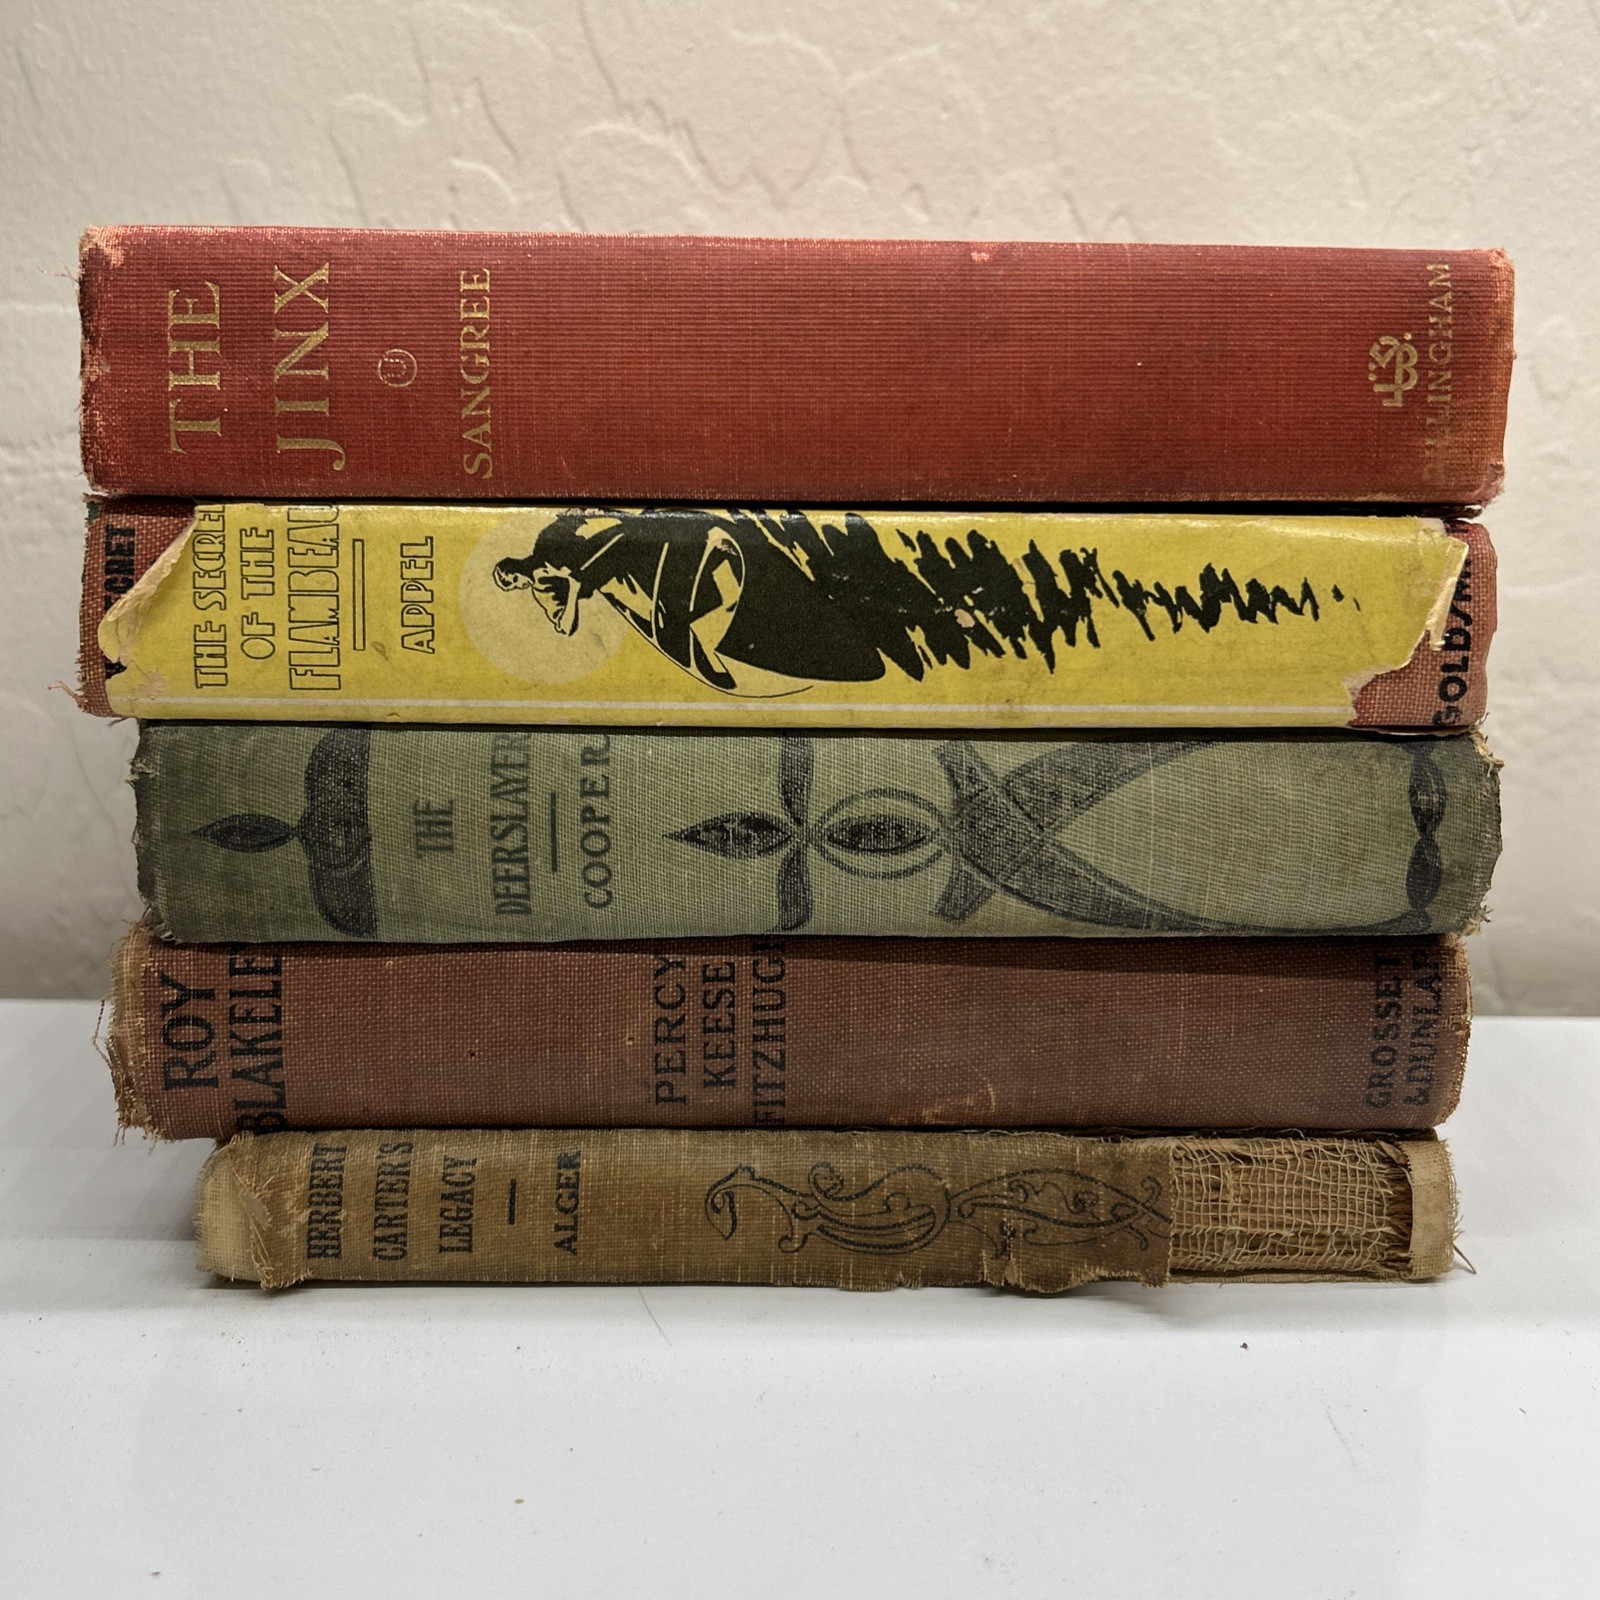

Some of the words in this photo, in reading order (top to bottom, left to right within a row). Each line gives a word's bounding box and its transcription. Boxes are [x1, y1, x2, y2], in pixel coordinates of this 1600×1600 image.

[168, 280, 222, 454] THE
[274, 262, 346, 471] JINX
[460, 267, 494, 480] SANGREE
[239, 527, 275, 600] THE
[400, 535, 435, 655] APPEL
[193, 620, 229, 690] THE
[240, 612, 276, 660] OF
[413, 799, 454, 860] THE
[580, 734, 613, 910] COOPER
[160, 971, 219, 1092] ROY
[653, 951, 687, 1106] PERCY
[702, 961, 736, 1089] KEESE
[1365, 951, 1402, 1109] GROSSET
[307, 1142, 347, 1260] HERBERT
[373, 1142, 414, 1262] CARTER'S
[438, 1155, 478, 1255] LEGACY
[554, 1149, 582, 1256] ALGER
